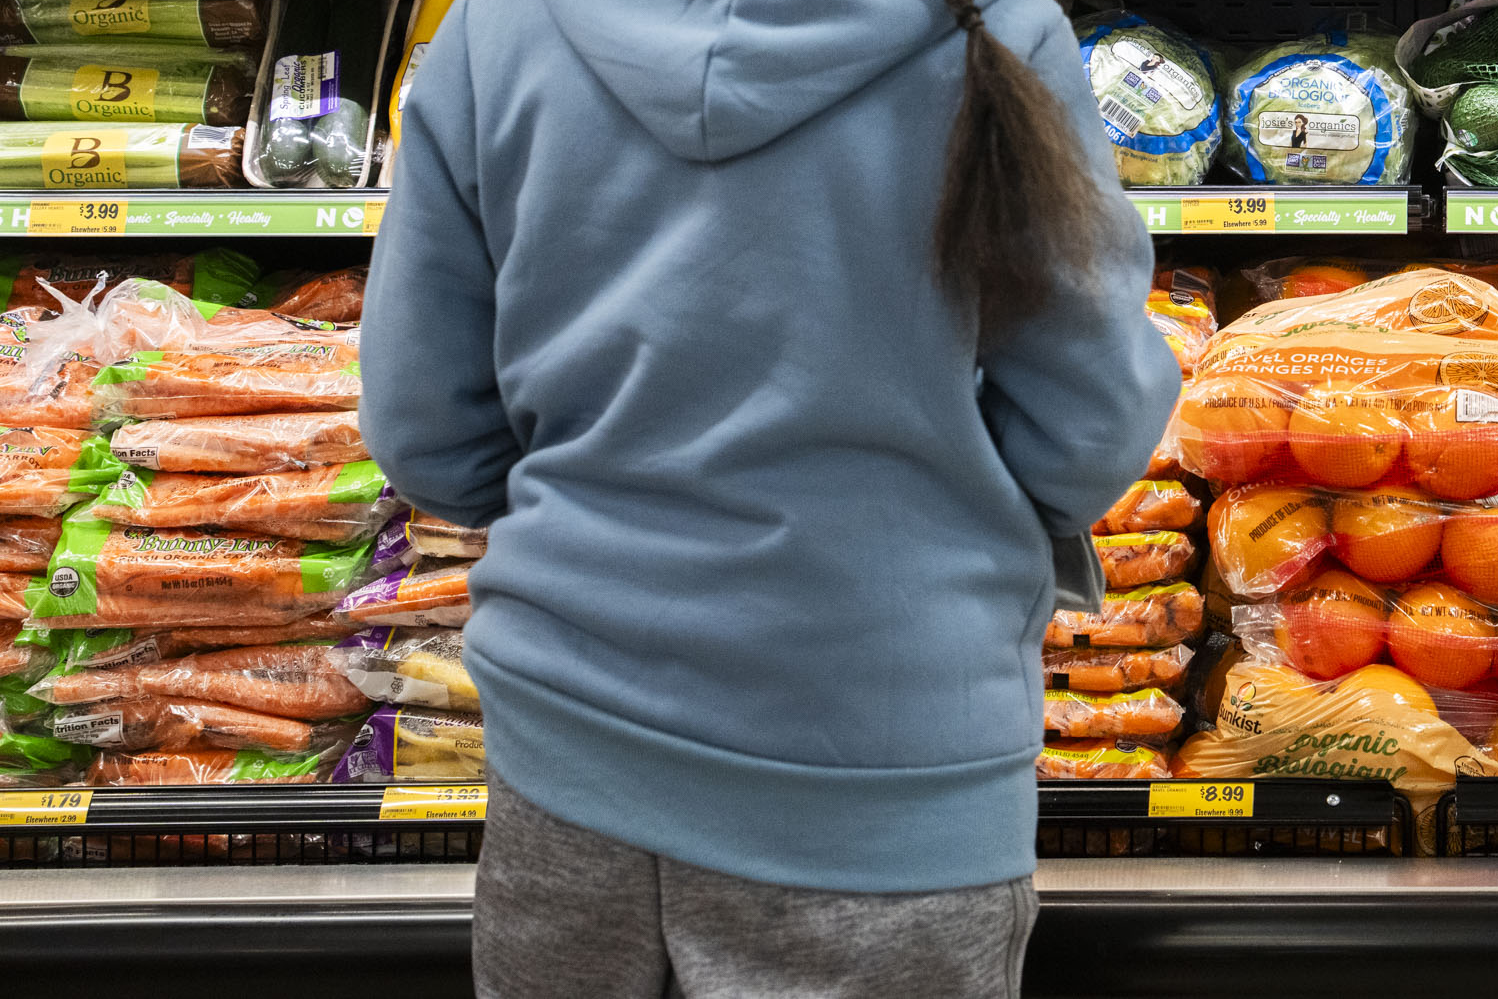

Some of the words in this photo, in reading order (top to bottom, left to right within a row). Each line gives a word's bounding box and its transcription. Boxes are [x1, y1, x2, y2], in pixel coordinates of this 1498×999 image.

[73, 8, 145, 25] Organic
[281, 63, 290, 80] Leaf
[280, 86, 291, 109] Spring
[76, 100, 149, 117] Organic
[1260, 118, 1294, 130] josie's
[1308, 118, 1356, 133] organics
[49, 168, 121, 186] Organic
[79, 203, 118, 220] $3.99
[1228, 198, 1267, 214] $3.99
[164, 211, 215, 226] Specialty
[228, 211, 271, 227] Healthy
[1223, 220, 1251, 228] Elsewhere
[1293, 210, 1341, 225] Specialty
[1353, 210, 1396, 225] Healthy
[1291, 353, 1388, 366] ORANGES
[1320, 365, 1386, 374] NAVEL
[41, 793, 82, 809] $1.79
[1200, 784, 1245, 803] $8.99
